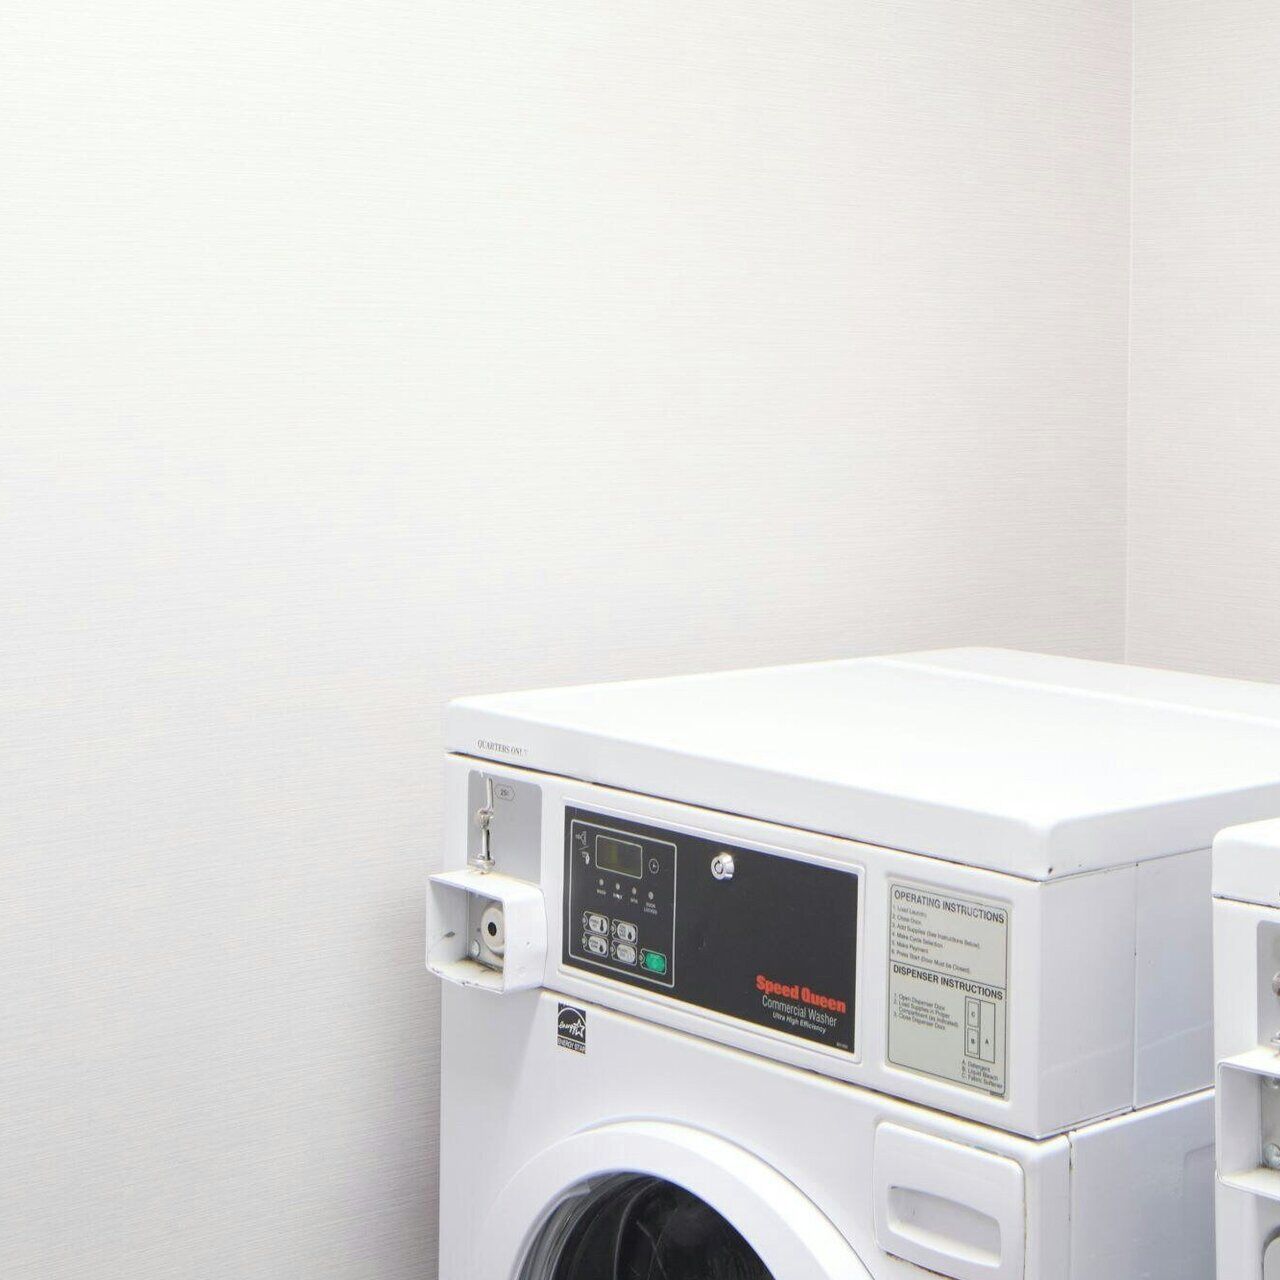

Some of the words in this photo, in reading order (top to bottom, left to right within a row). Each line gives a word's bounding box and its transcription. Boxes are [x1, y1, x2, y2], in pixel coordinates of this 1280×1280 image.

[477, 740, 510, 753] QUARTERS
[894, 890, 940, 908] OPERATING
[942, 901, 1004, 924] INSTRUCTIONS
[756, 974, 799, 999] Speed
[801, 987, 846, 1013] Queen
[893, 964, 939, 984] DISPENSER
[940, 978, 1003, 1000] INSTRUCTIONS
[762, 994, 807, 1018] Commercial
[808, 1009, 838, 1027] Washer
[772, 1011, 785, 1021] Ultra
[786, 1015, 799, 1026] High
[800, 1020, 826, 1034] Efficiency
